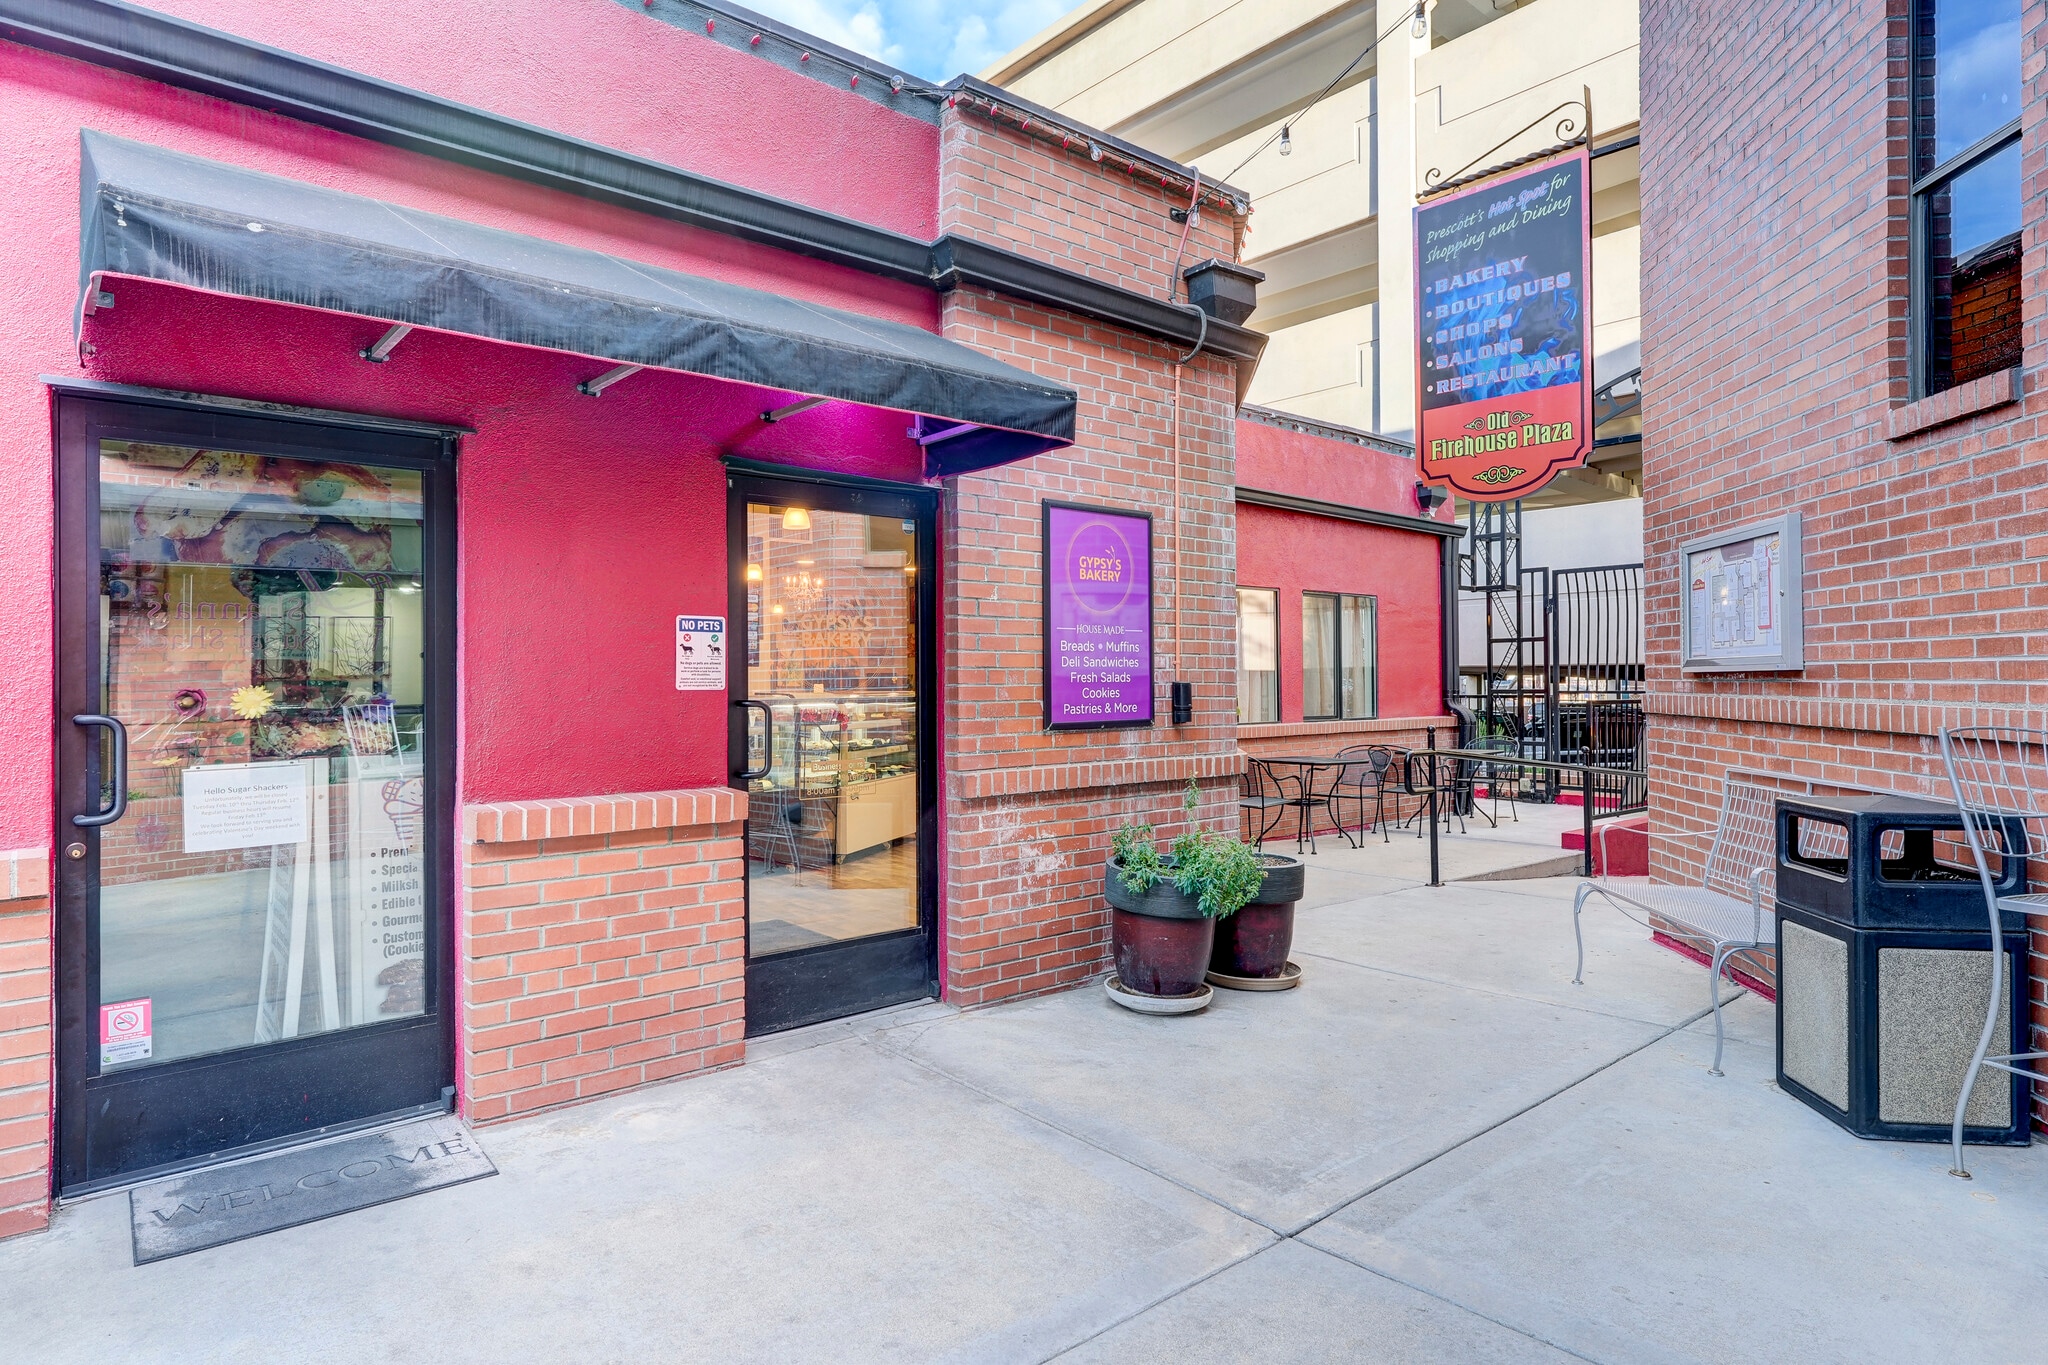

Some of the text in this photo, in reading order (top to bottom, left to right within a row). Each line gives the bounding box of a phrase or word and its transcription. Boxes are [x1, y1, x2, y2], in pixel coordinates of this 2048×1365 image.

[1426, 173, 1571, 245] Prescott's Hot Spot for
[1488, 215, 1519, 239] and
[1522, 195, 1572, 224] Dining
[1435, 255, 1528, 294] BAKERY
[1435, 271, 1572, 319] BOUTIQUES
[1435, 313, 1513, 345] SHOPS
[1435, 337, 1524, 370] SALONS
[1435, 353, 1577, 395] RESTAURANT
[1486, 411, 1512, 431] Old
[1429, 421, 1575, 462] Firehouse Plaza
[1079, 556, 1122, 571] GYPSY'S
[1079, 568, 1121, 583] BAKERY
[681, 620, 720, 631] NO PETS
[800, 614, 875, 631] GYPSY'S
[1076, 624, 1125, 635] HOUSE MADE
[801, 632, 872, 648] BAKERY
[1060, 640, 1139, 653] Breads Muffins
[1061, 656, 1139, 668] Deli Sandwiches
[1070, 672, 1131, 683] Fresh Salads
[1082, 687, 1120, 698] Cookies
[1063, 703, 1138, 715] Pastries & More
[204, 787, 226, 795] Hello
[227, 785, 251, 794] Sugar
[806, 787, 835, 796] 8:00am
[381, 879, 419, 893] Milksh
[382, 897, 416, 910] Edible
[383, 930, 424, 944] Custom
[383, 942, 425, 958] (Cookie
[150, 1137, 473, 1227] WELCOME
